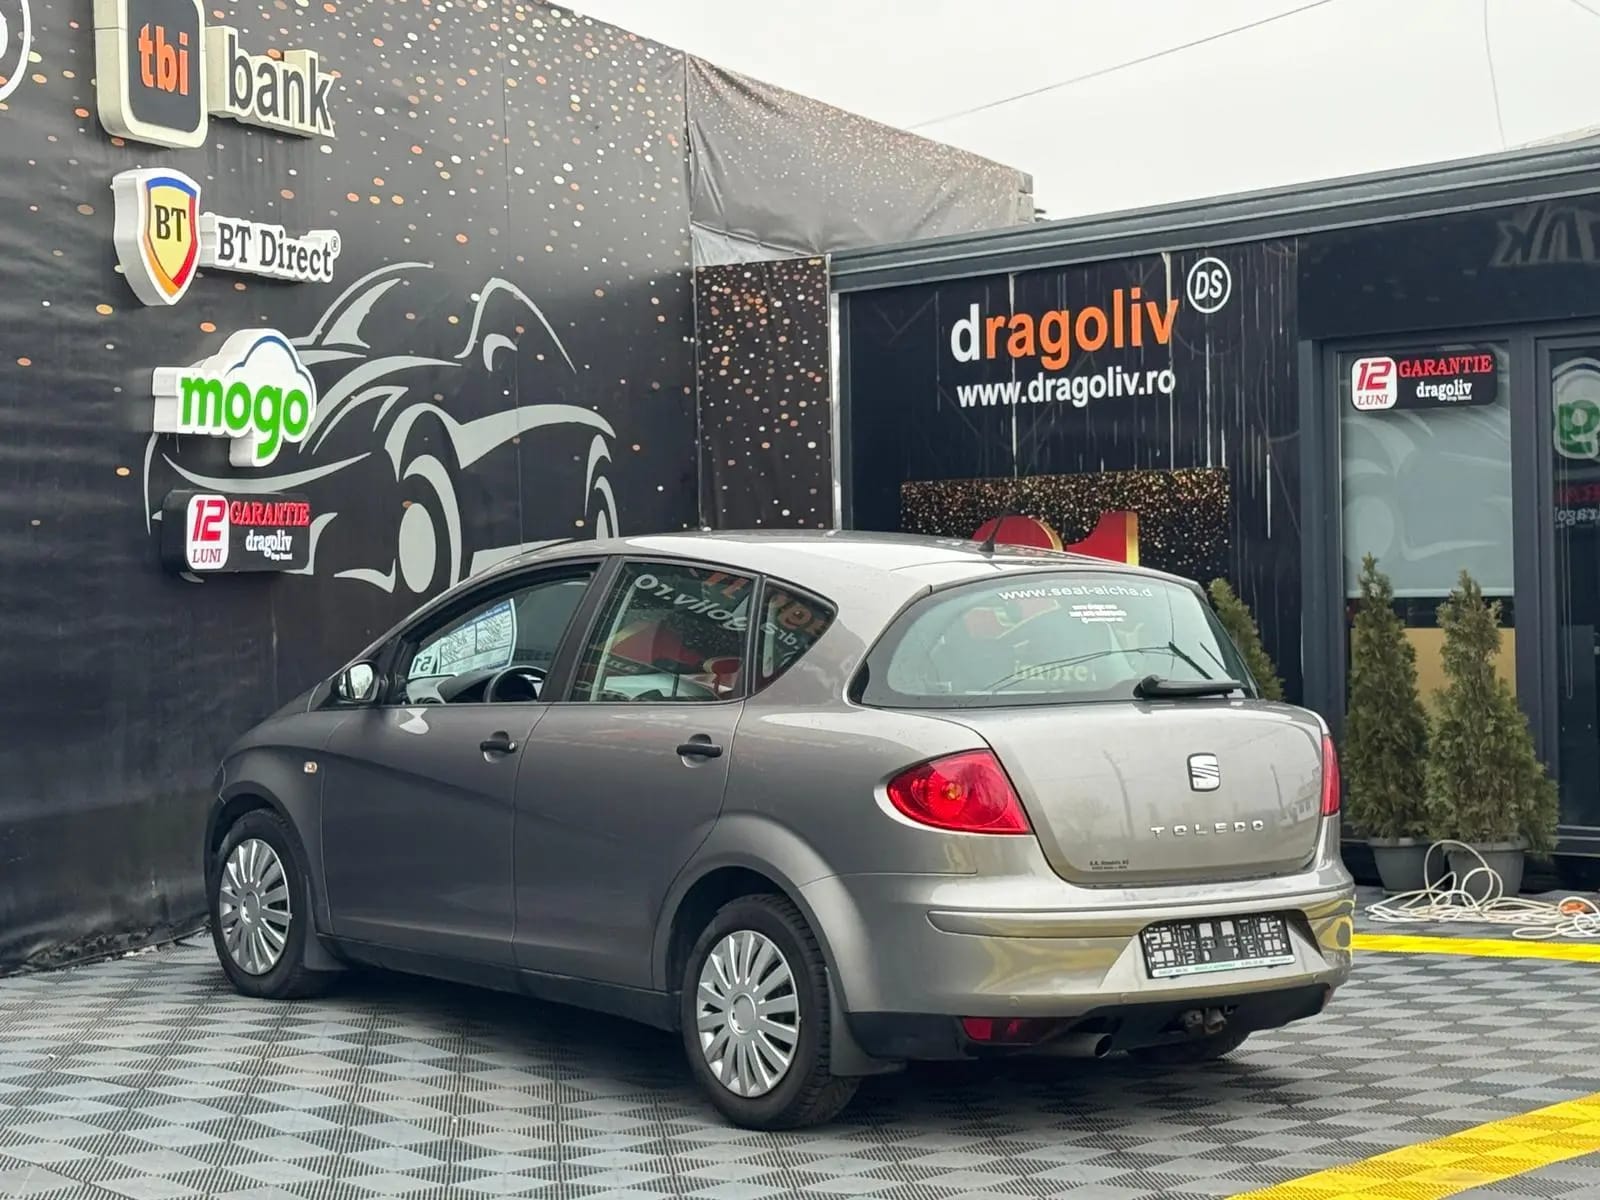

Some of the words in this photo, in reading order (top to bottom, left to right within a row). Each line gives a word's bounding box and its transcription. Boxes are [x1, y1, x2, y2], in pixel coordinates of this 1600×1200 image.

[138, 24, 189, 96] tbi
[228, 34, 331, 134] bank
[155, 205, 187, 242] BT
[218, 222, 251, 263] BT
[1194, 269, 1224, 301] DS
[950, 287, 1180, 370] dragoliv
[1357, 361, 1392, 391] 12
[1399, 355, 1493, 378] GARANTIE
[957, 366, 1176, 408] www.dragoliv.ro
[1357, 394, 1388, 406] LUNI
[1416, 379, 1473, 401] dragoliv
[180, 376, 309, 460] mogo
[192, 499, 225, 542] 12
[230, 501, 310, 526] GARANTIE
[192, 548, 222, 563] LUNI
[245, 529, 293, 558] dragoliv
[1151, 820, 1263, 839] TOLEDO
